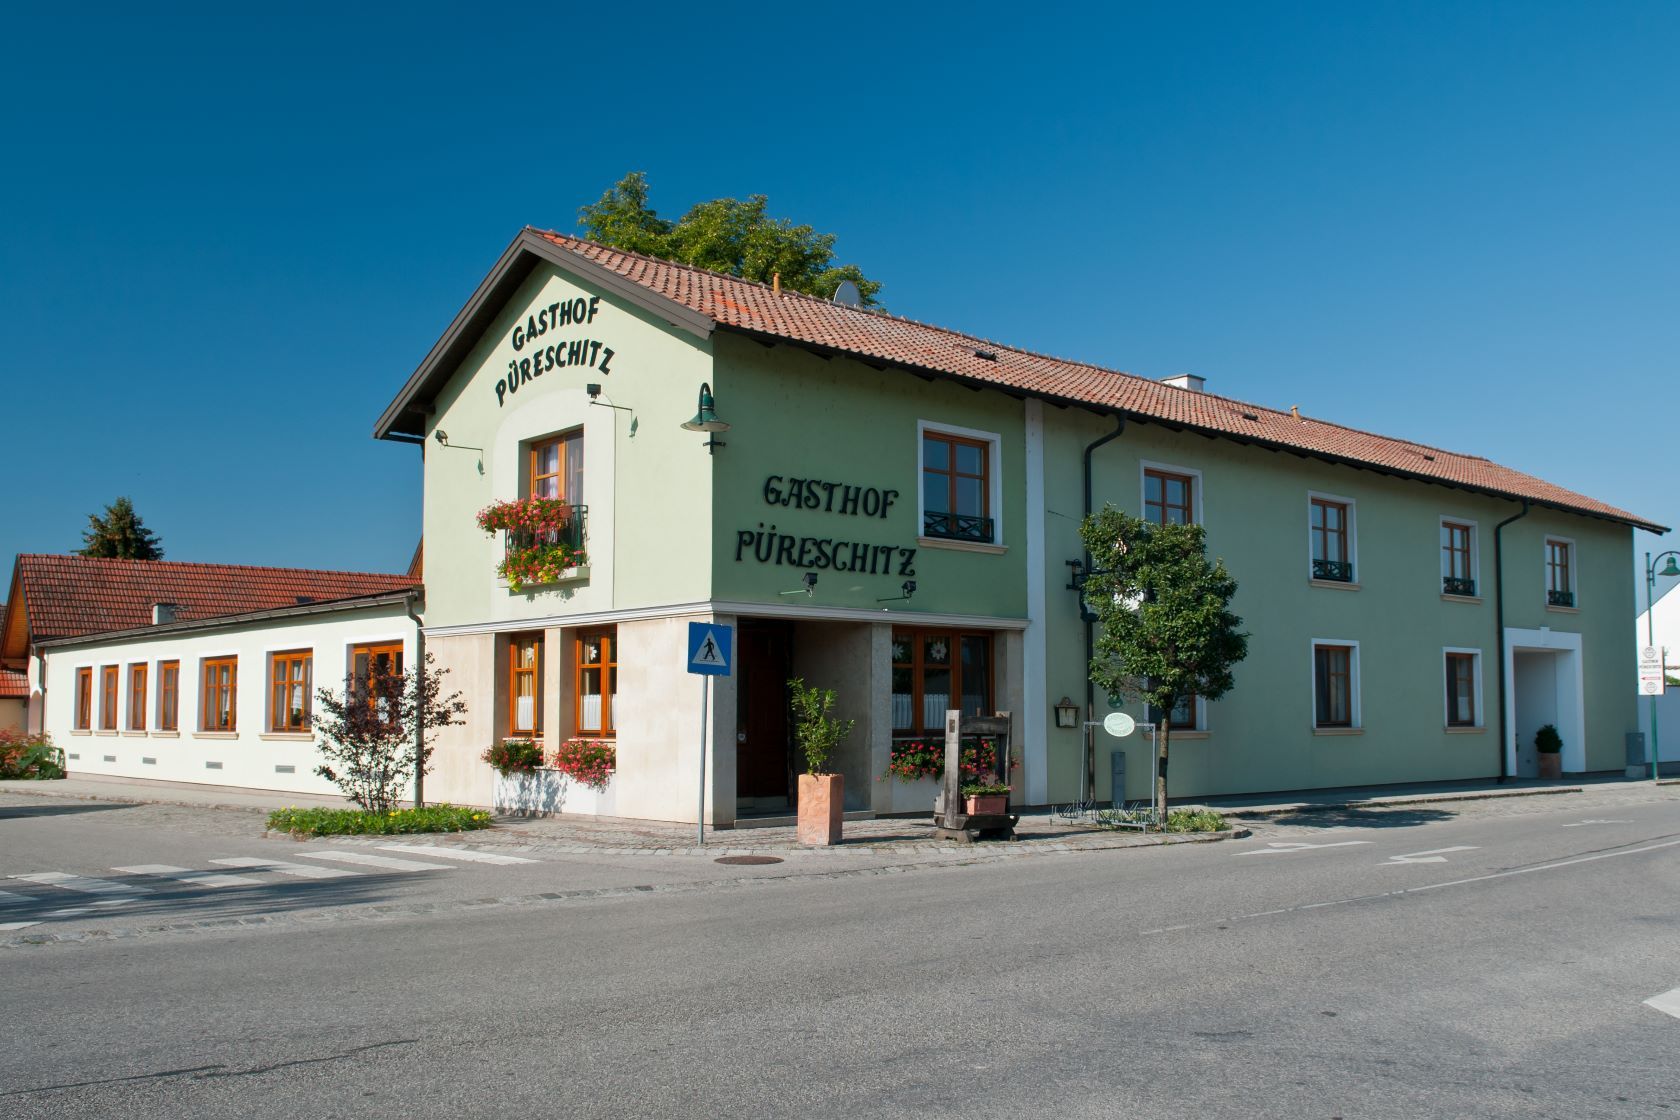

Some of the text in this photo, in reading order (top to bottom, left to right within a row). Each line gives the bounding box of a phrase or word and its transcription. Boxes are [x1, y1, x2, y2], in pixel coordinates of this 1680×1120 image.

[512, 296, 600, 351] GASTHOF
[495, 339, 615, 407] PÜRESCHITZ
[764, 475, 899, 519] GASTHOF
[735, 522, 917, 577] PÜRESCHITZ
